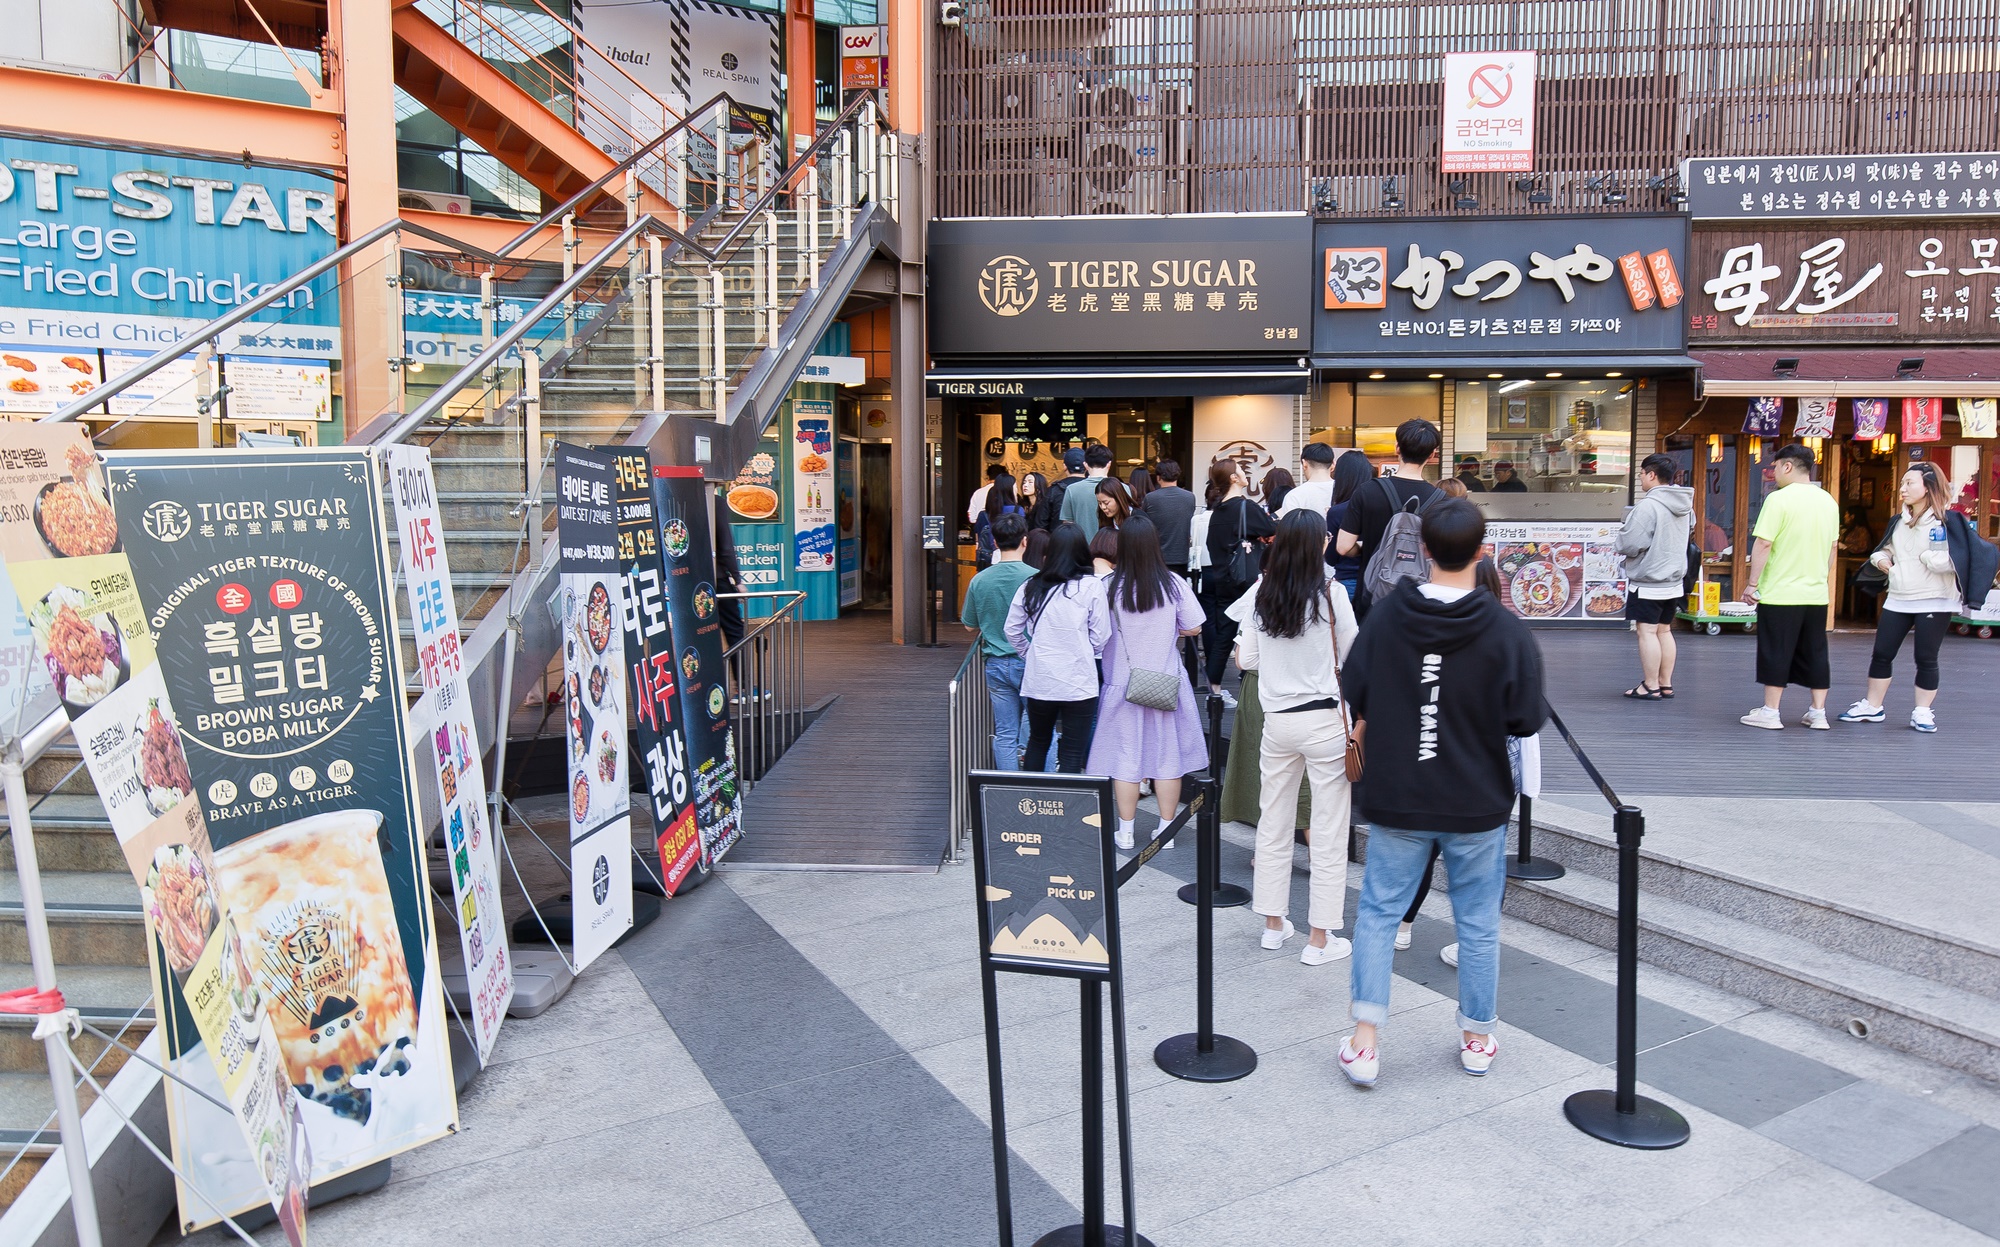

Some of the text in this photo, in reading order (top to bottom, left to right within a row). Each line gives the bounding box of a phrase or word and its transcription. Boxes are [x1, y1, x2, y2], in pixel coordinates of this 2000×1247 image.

[845, 35, 873, 49] CGV
[702, 68, 760, 85] REAL SPAIN
[1456, 118, 1523, 137] 금연구역
[1478, 140, 1513, 148] Smoking
[1703, 164, 1760, 185] 일본에서
[1770, 163, 1856, 184] 장인(匠人)의
[1866, 161, 1923, 183] 맛(味)을
[1762, 191, 1806, 212] 업소는
[1048, 259, 1258, 288] TIGER SUGAR
[1392, 243, 1614, 311] かつや
[1624, 256, 1650, 302] とんかつ
[1654, 255, 1678, 299] カツ丼
[1704, 238, 1883, 326] 母屋
[1691, 315, 1718, 330] 본점
[1920, 306, 1969, 323] 돈부리
[28, 319, 100, 339] Fried
[1263, 327, 1299, 339] 강남점
[937, 383, 1023, 395] TIGER SUGAR
[1805, 401, 1825, 435] うどん
[561, 475, 609, 507] 데이트 세트
[197, 498, 349, 522] TIGER SUGAR
[561, 505, 576, 520] DATE
[576, 507, 588, 522] SET
[409, 517, 437, 572] 사주
[637, 529, 656, 557] 오픈
[1500, 528, 1527, 539] 강남점
[756, 543, 779, 552] Fried
[151, 555, 383, 684] ORIGINAL TIGER TEXTURE OF BROWN SUGAR
[416, 579, 447, 635] 타로
[203, 612, 324, 658] 흑설탕
[208, 655, 330, 705] 밀크티
[634, 650, 676, 732] 사주
[196, 695, 345, 732] BROWN SUGAR
[222, 716, 331, 749] BOBA MILK
[647, 729, 687, 822] 관상
[208, 784, 358, 822] BRAVE AS A TIGER.
[1037, 800, 1064, 808] TIGER
[1037, 808, 1065, 816] SUGAR
[675, 830, 686, 853] CGV
[1000, 831, 1042, 844] ORDER
[1047, 887, 1096, 901] PICK UP
[295, 957, 343, 985] TIGER
[301, 970, 345, 998] SUGAR
